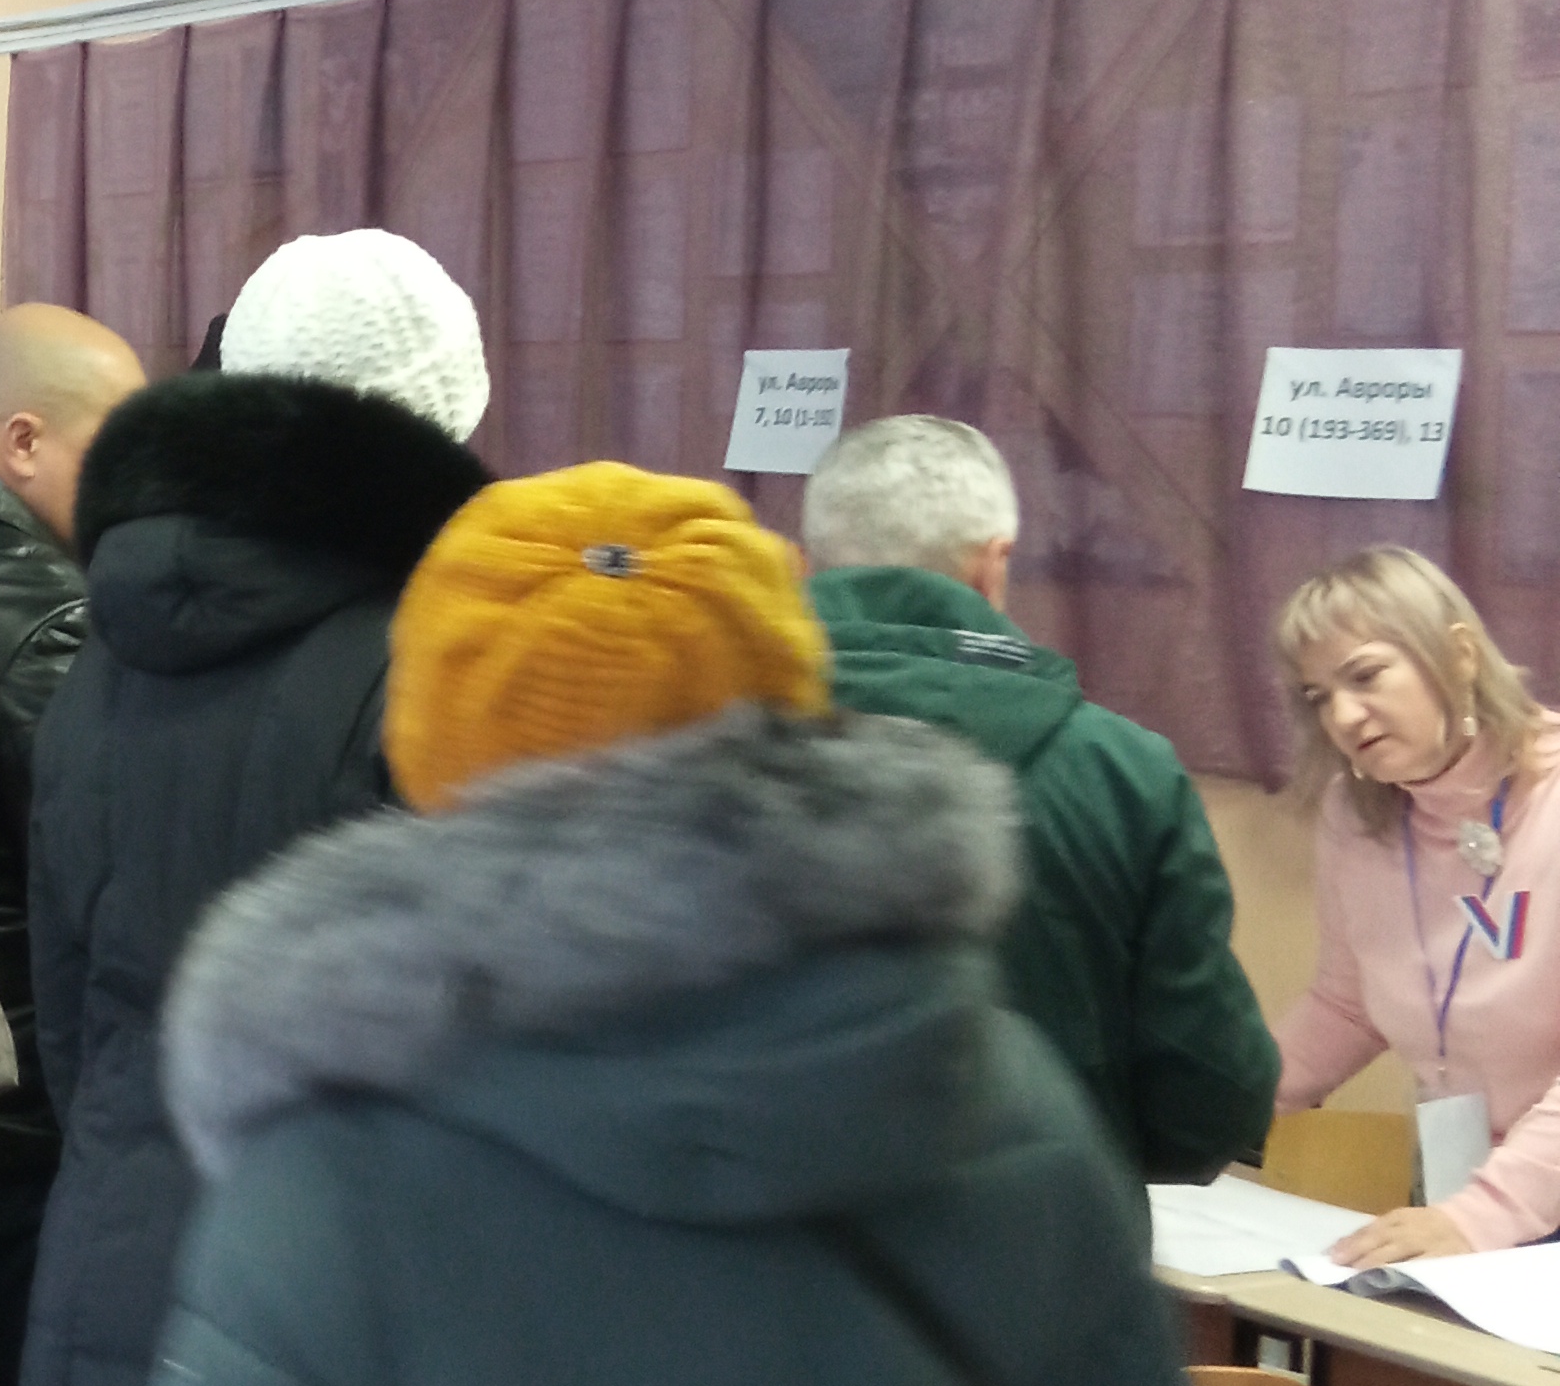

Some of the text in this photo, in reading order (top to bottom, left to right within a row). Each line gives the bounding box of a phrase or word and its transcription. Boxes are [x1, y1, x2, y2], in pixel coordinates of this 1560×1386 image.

[1290, 377, 1433, 404] ул. Авроры
[1260, 416, 1292, 437] 10
[1419, 421, 1445, 442] 13
